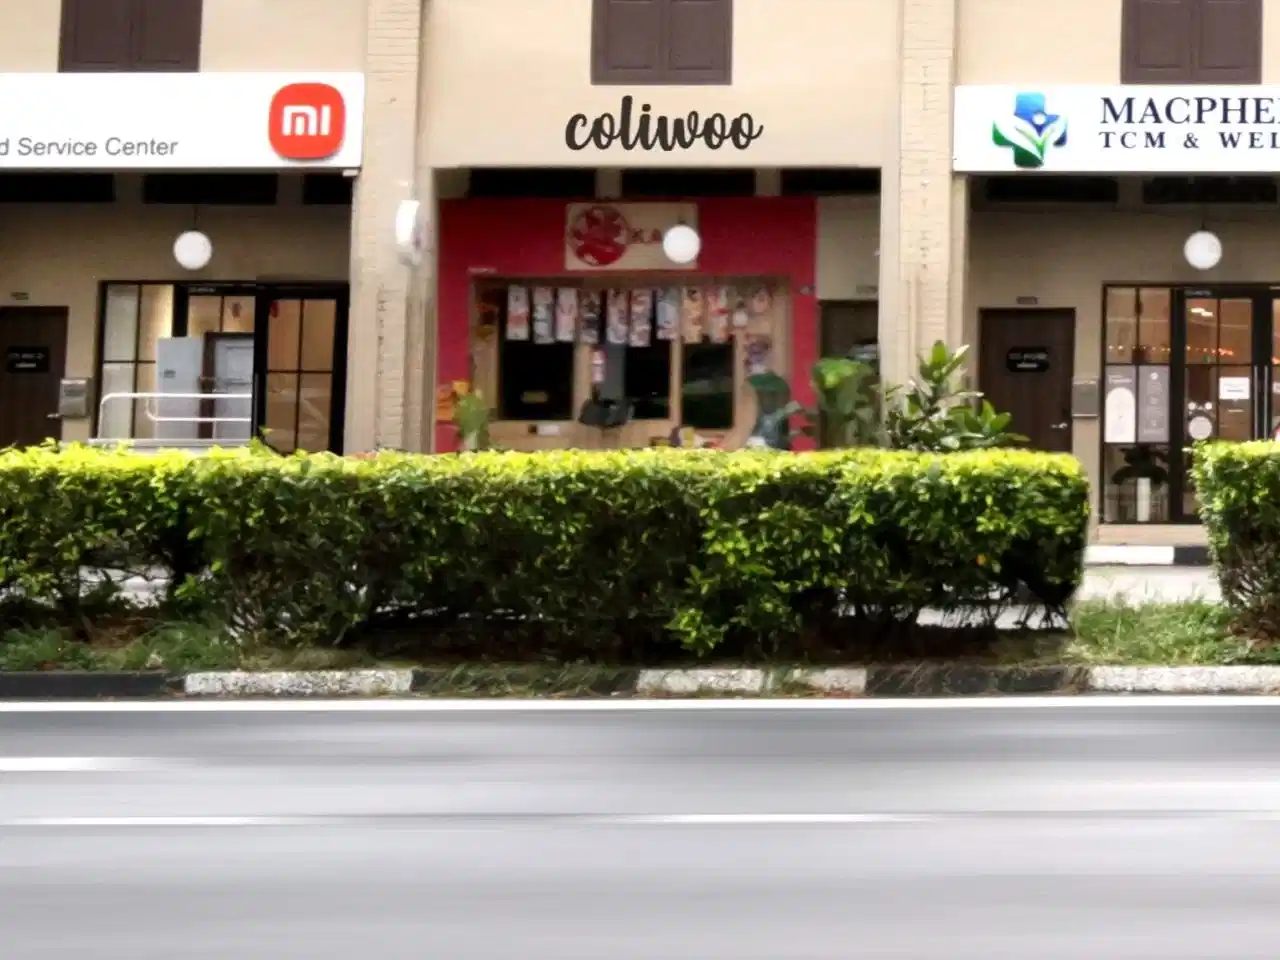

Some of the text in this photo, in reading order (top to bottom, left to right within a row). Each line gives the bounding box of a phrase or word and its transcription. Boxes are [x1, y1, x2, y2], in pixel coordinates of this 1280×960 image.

[565, 95, 764, 152] coliwoo
[18, 137, 97, 156] Service
[105, 137, 178, 156] Center
[1099, 131, 1166, 149] TCM
[1183, 131, 1199, 149] &
